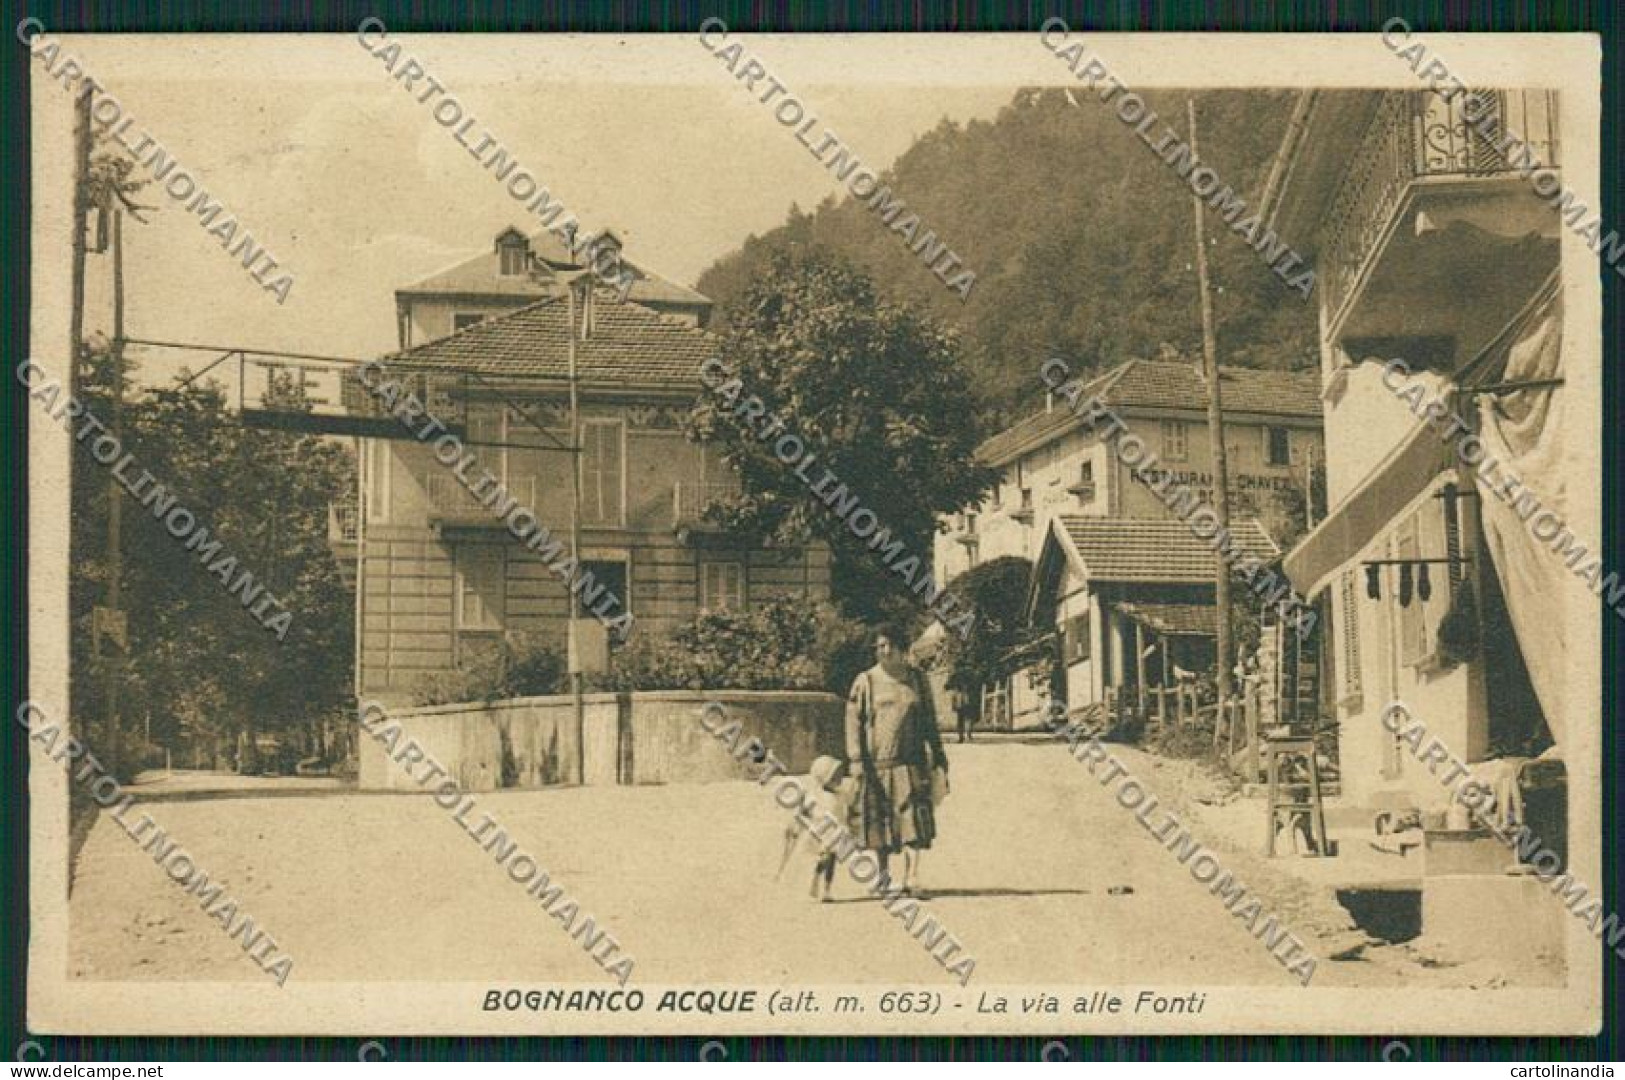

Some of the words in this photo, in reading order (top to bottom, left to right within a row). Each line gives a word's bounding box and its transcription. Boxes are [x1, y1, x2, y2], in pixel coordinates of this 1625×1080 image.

[482, 989, 645, 1012] BOGNANCO
[656, 990, 757, 1014] ACQUE
[767, 990, 820, 1015] (alt.
[834, 996, 864, 1013] m.
[879, 990, 942, 1015] 663)
[976, 991, 1009, 1013] La
[1021, 992, 1060, 1013] via
[1073, 991, 1122, 1014] alle
[1134, 991, 1207, 1014] Fonti
